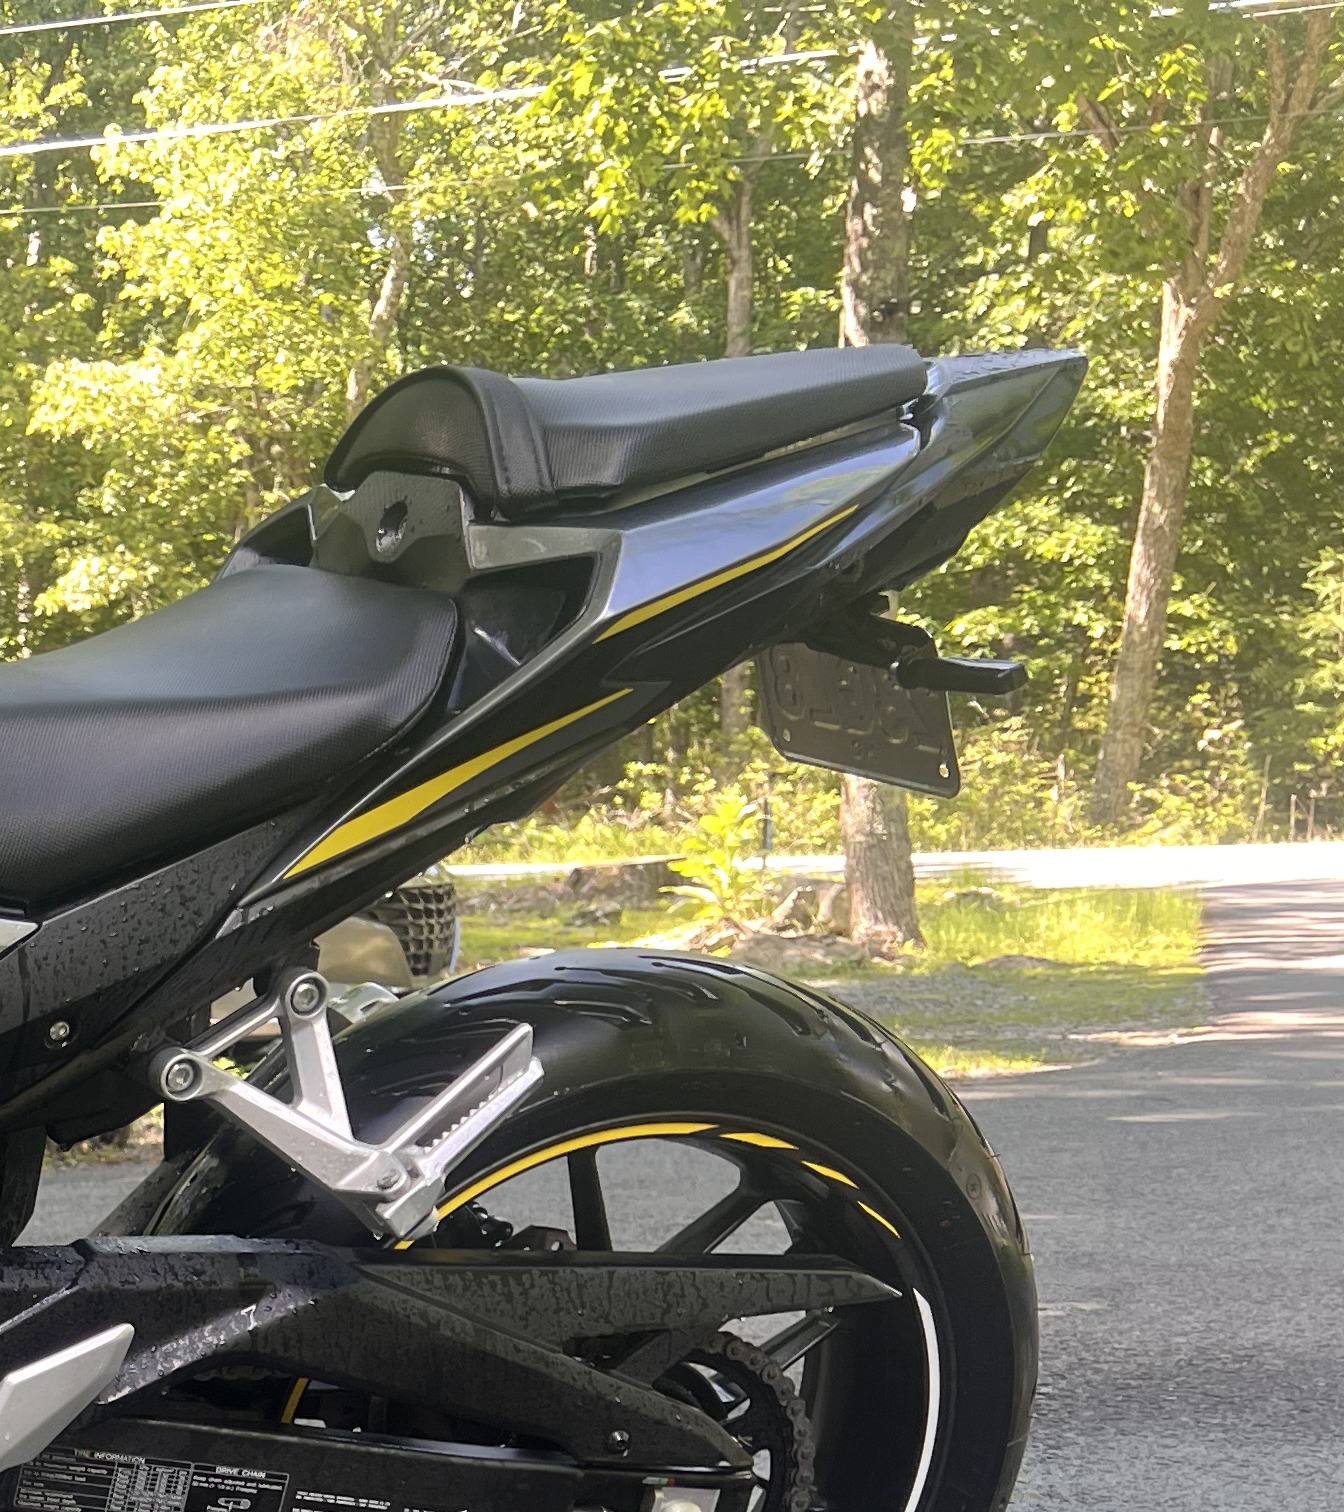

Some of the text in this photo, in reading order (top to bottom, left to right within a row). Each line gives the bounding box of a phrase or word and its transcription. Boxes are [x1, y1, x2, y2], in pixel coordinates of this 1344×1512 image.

[93, 1451, 146, 1465] INFORMATION
[215, 1465, 266, 1479] DRIVE CHAIN
